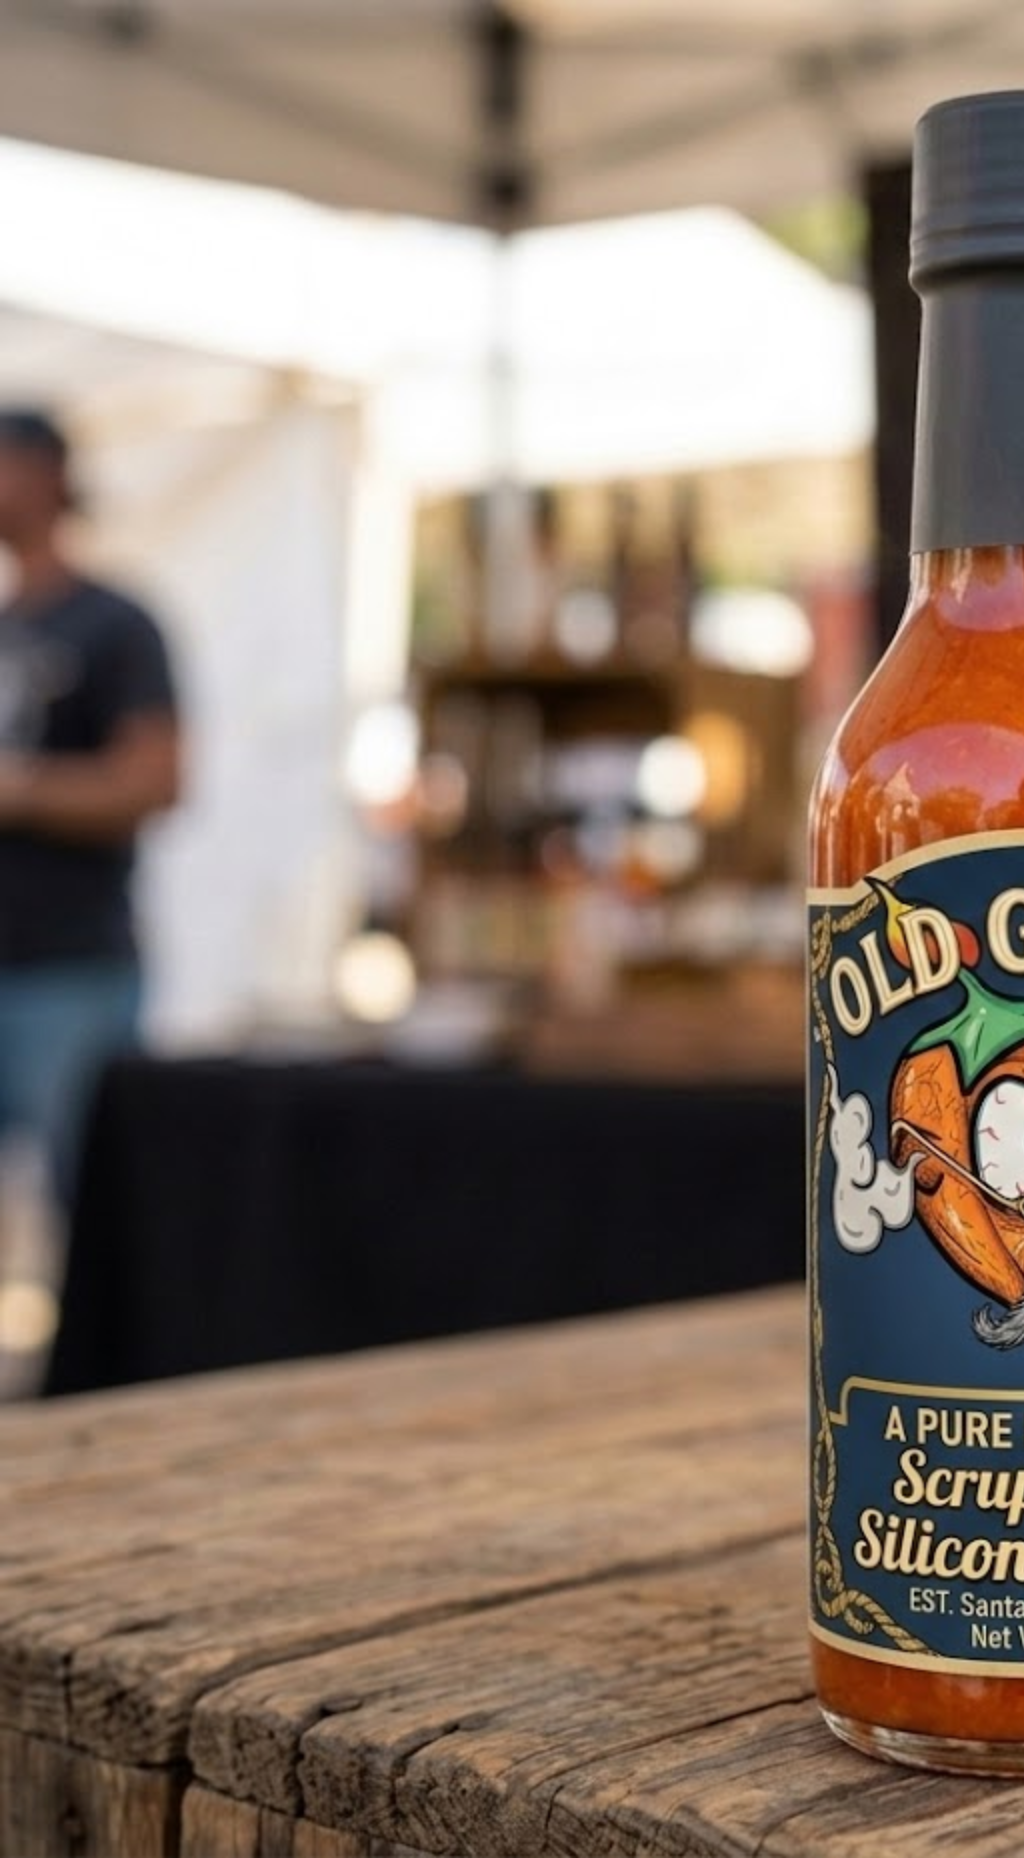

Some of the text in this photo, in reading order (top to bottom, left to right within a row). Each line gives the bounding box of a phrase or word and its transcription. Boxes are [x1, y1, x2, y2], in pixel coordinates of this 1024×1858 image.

[829, 907, 962, 1036] OLD
[884, 1406, 906, 1442] A
[917, 1410, 1013, 1448] PURE
[909, 1587, 954, 1615] EST.
[970, 1625, 1011, 1650] Net
